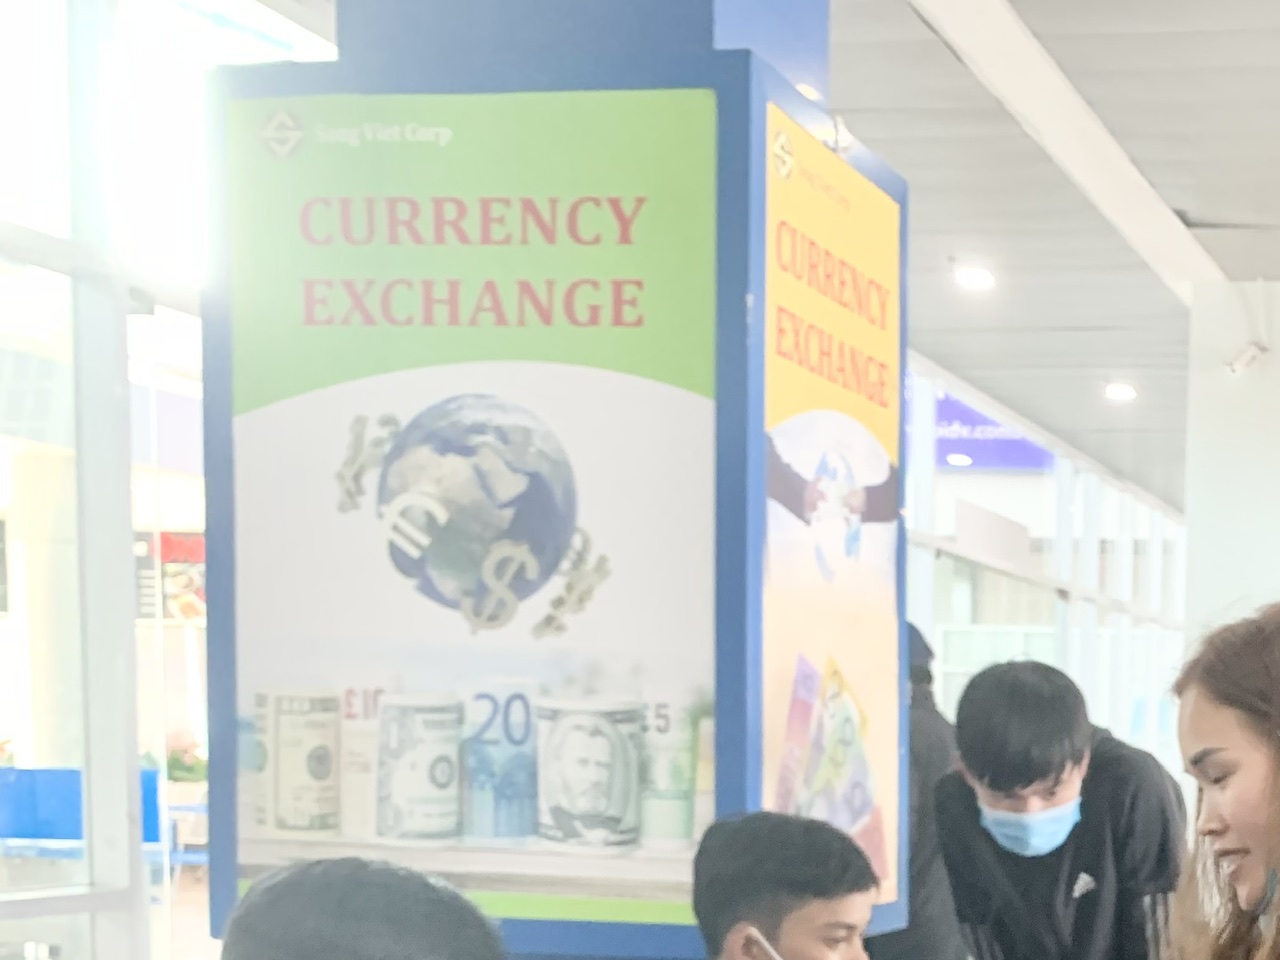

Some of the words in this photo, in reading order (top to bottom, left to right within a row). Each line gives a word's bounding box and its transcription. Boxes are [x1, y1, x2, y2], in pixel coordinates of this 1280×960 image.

[300, 195, 648, 246] CURRENCY
[776, 220, 891, 331] CURRENCY
[301, 278, 647, 328] EXCHANGE
[776, 305, 890, 409] EXCHANGE
[473, 692, 532, 746] 20
